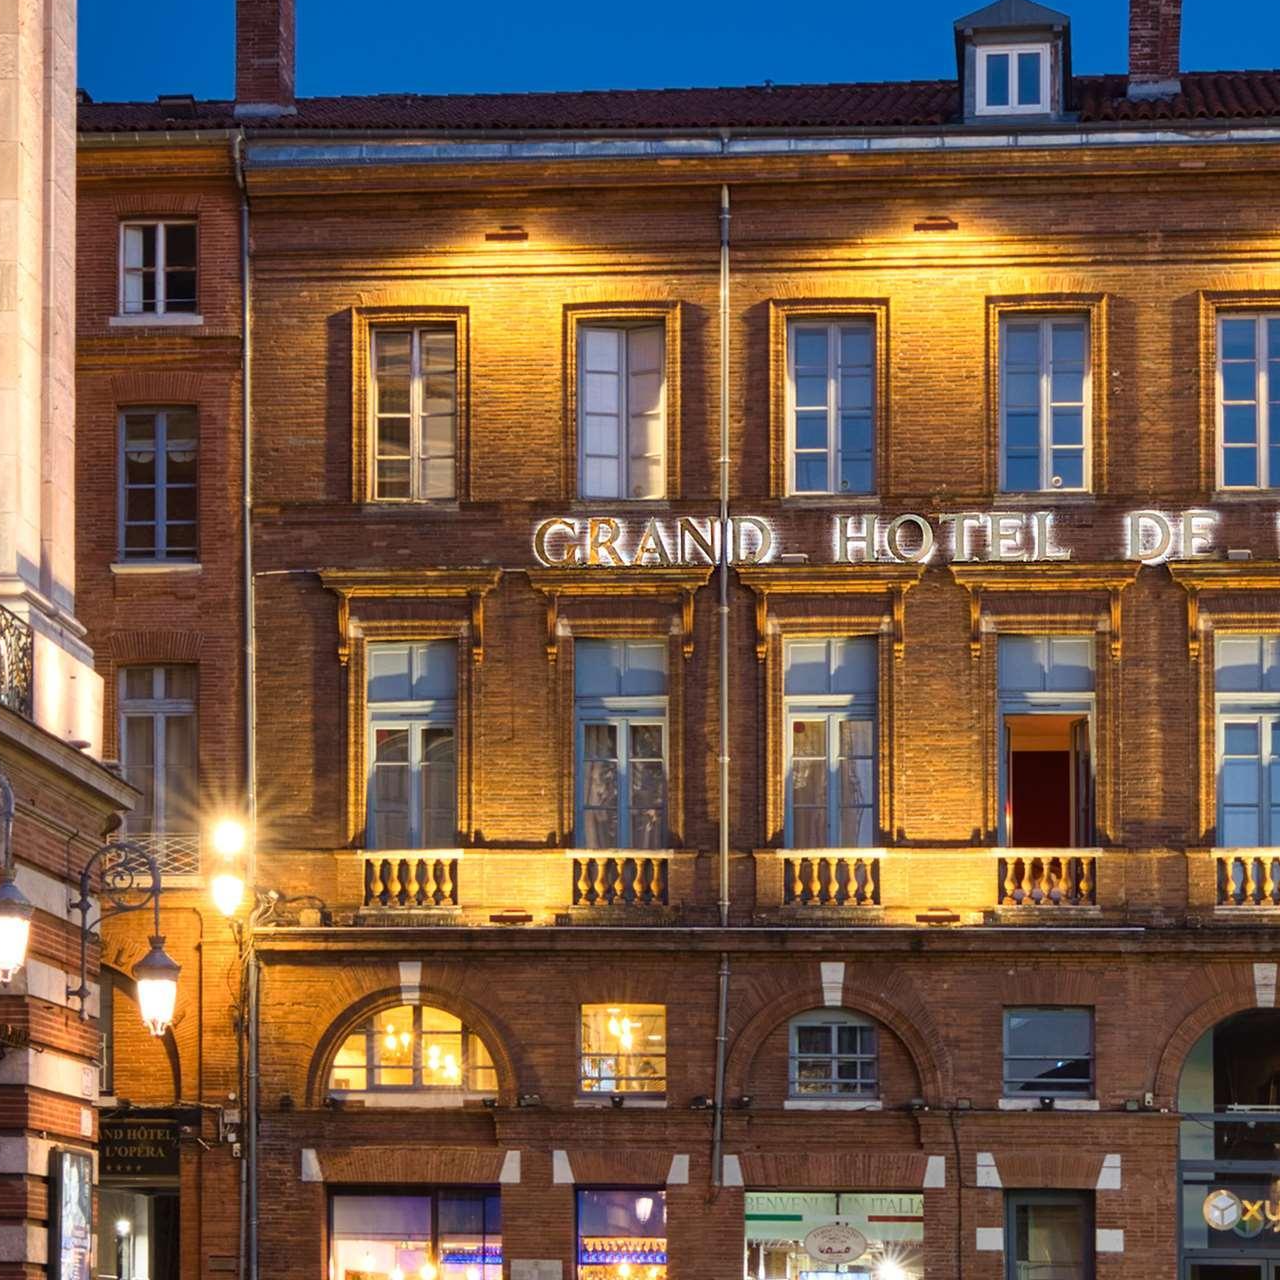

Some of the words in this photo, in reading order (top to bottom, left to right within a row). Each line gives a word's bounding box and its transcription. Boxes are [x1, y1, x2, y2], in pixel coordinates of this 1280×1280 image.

[533, 516, 772, 566] GRAND
[835, 511, 1073, 563] HOTEL
[1126, 508, 1221, 562] DE
